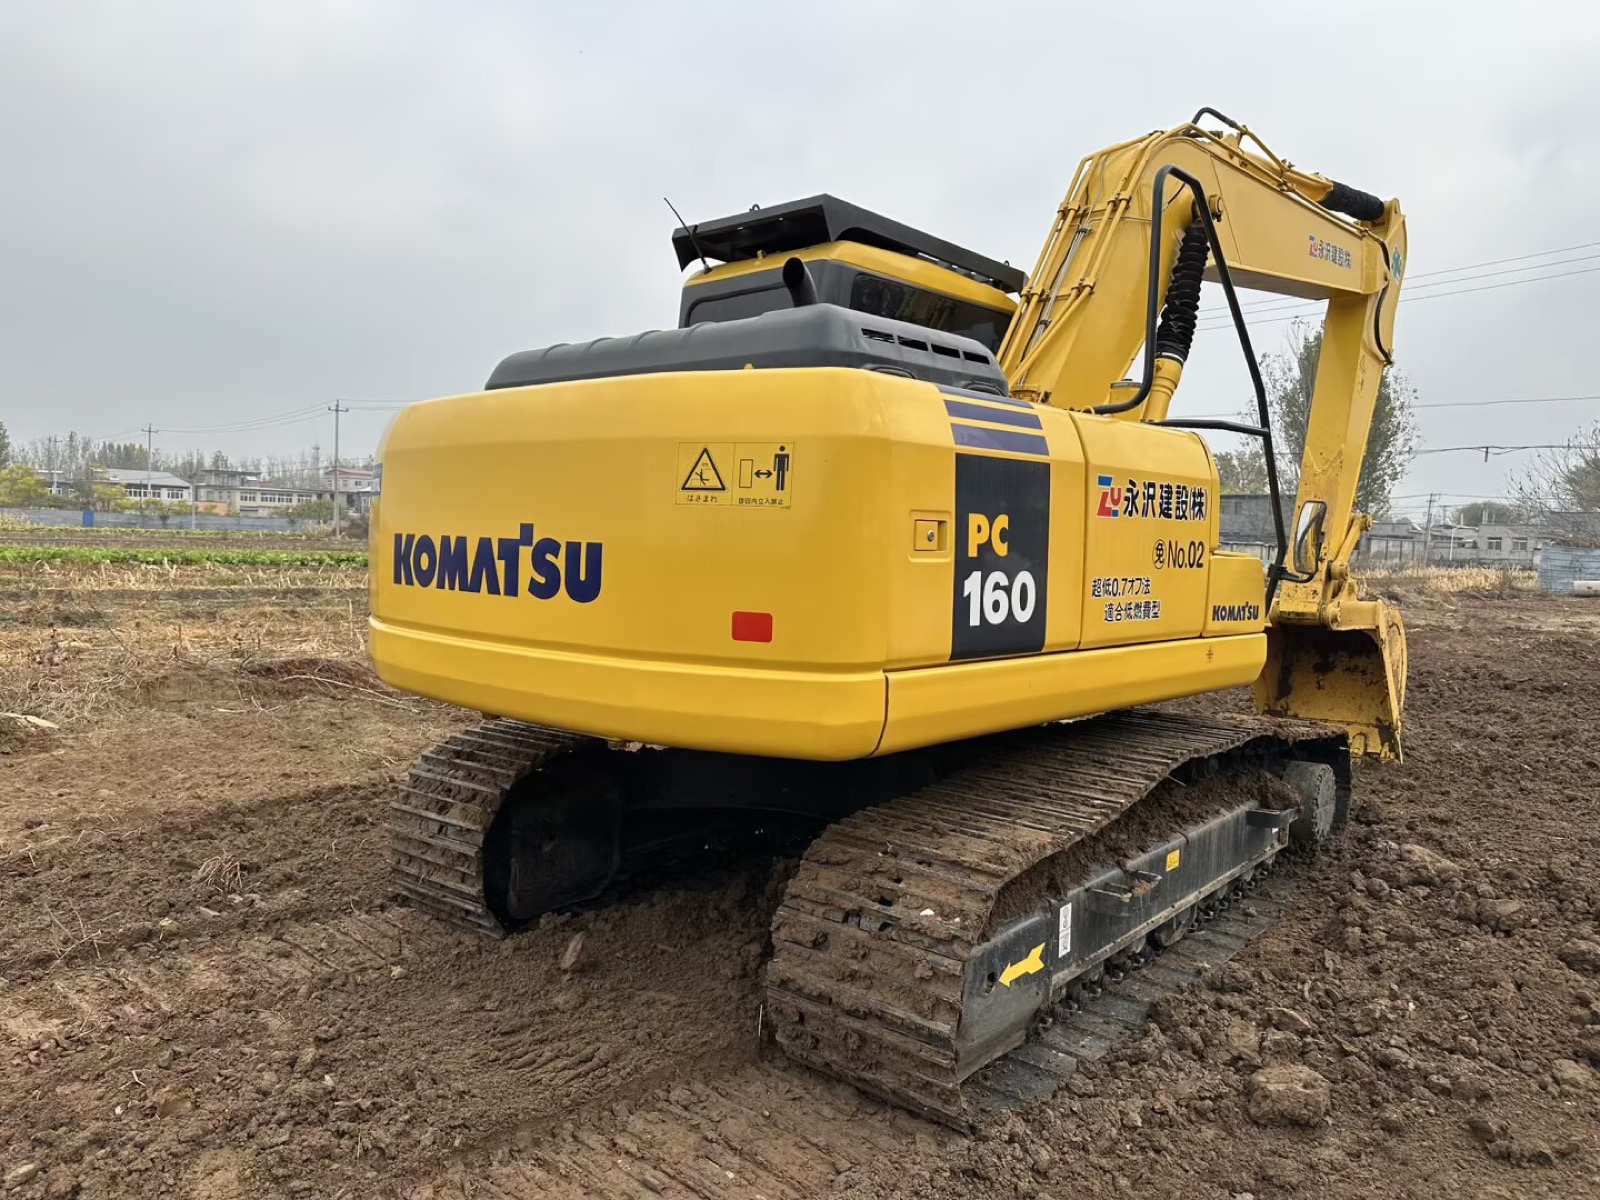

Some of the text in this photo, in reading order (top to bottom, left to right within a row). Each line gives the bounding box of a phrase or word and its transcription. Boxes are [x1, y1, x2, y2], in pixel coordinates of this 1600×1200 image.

[968, 512, 1009, 558] PC
[1168, 540, 1204, 569] No.02
[393, 523, 603, 603] KOMATSU
[963, 570, 1036, 627] 160
[1212, 602, 1259, 621] KOMATSU
